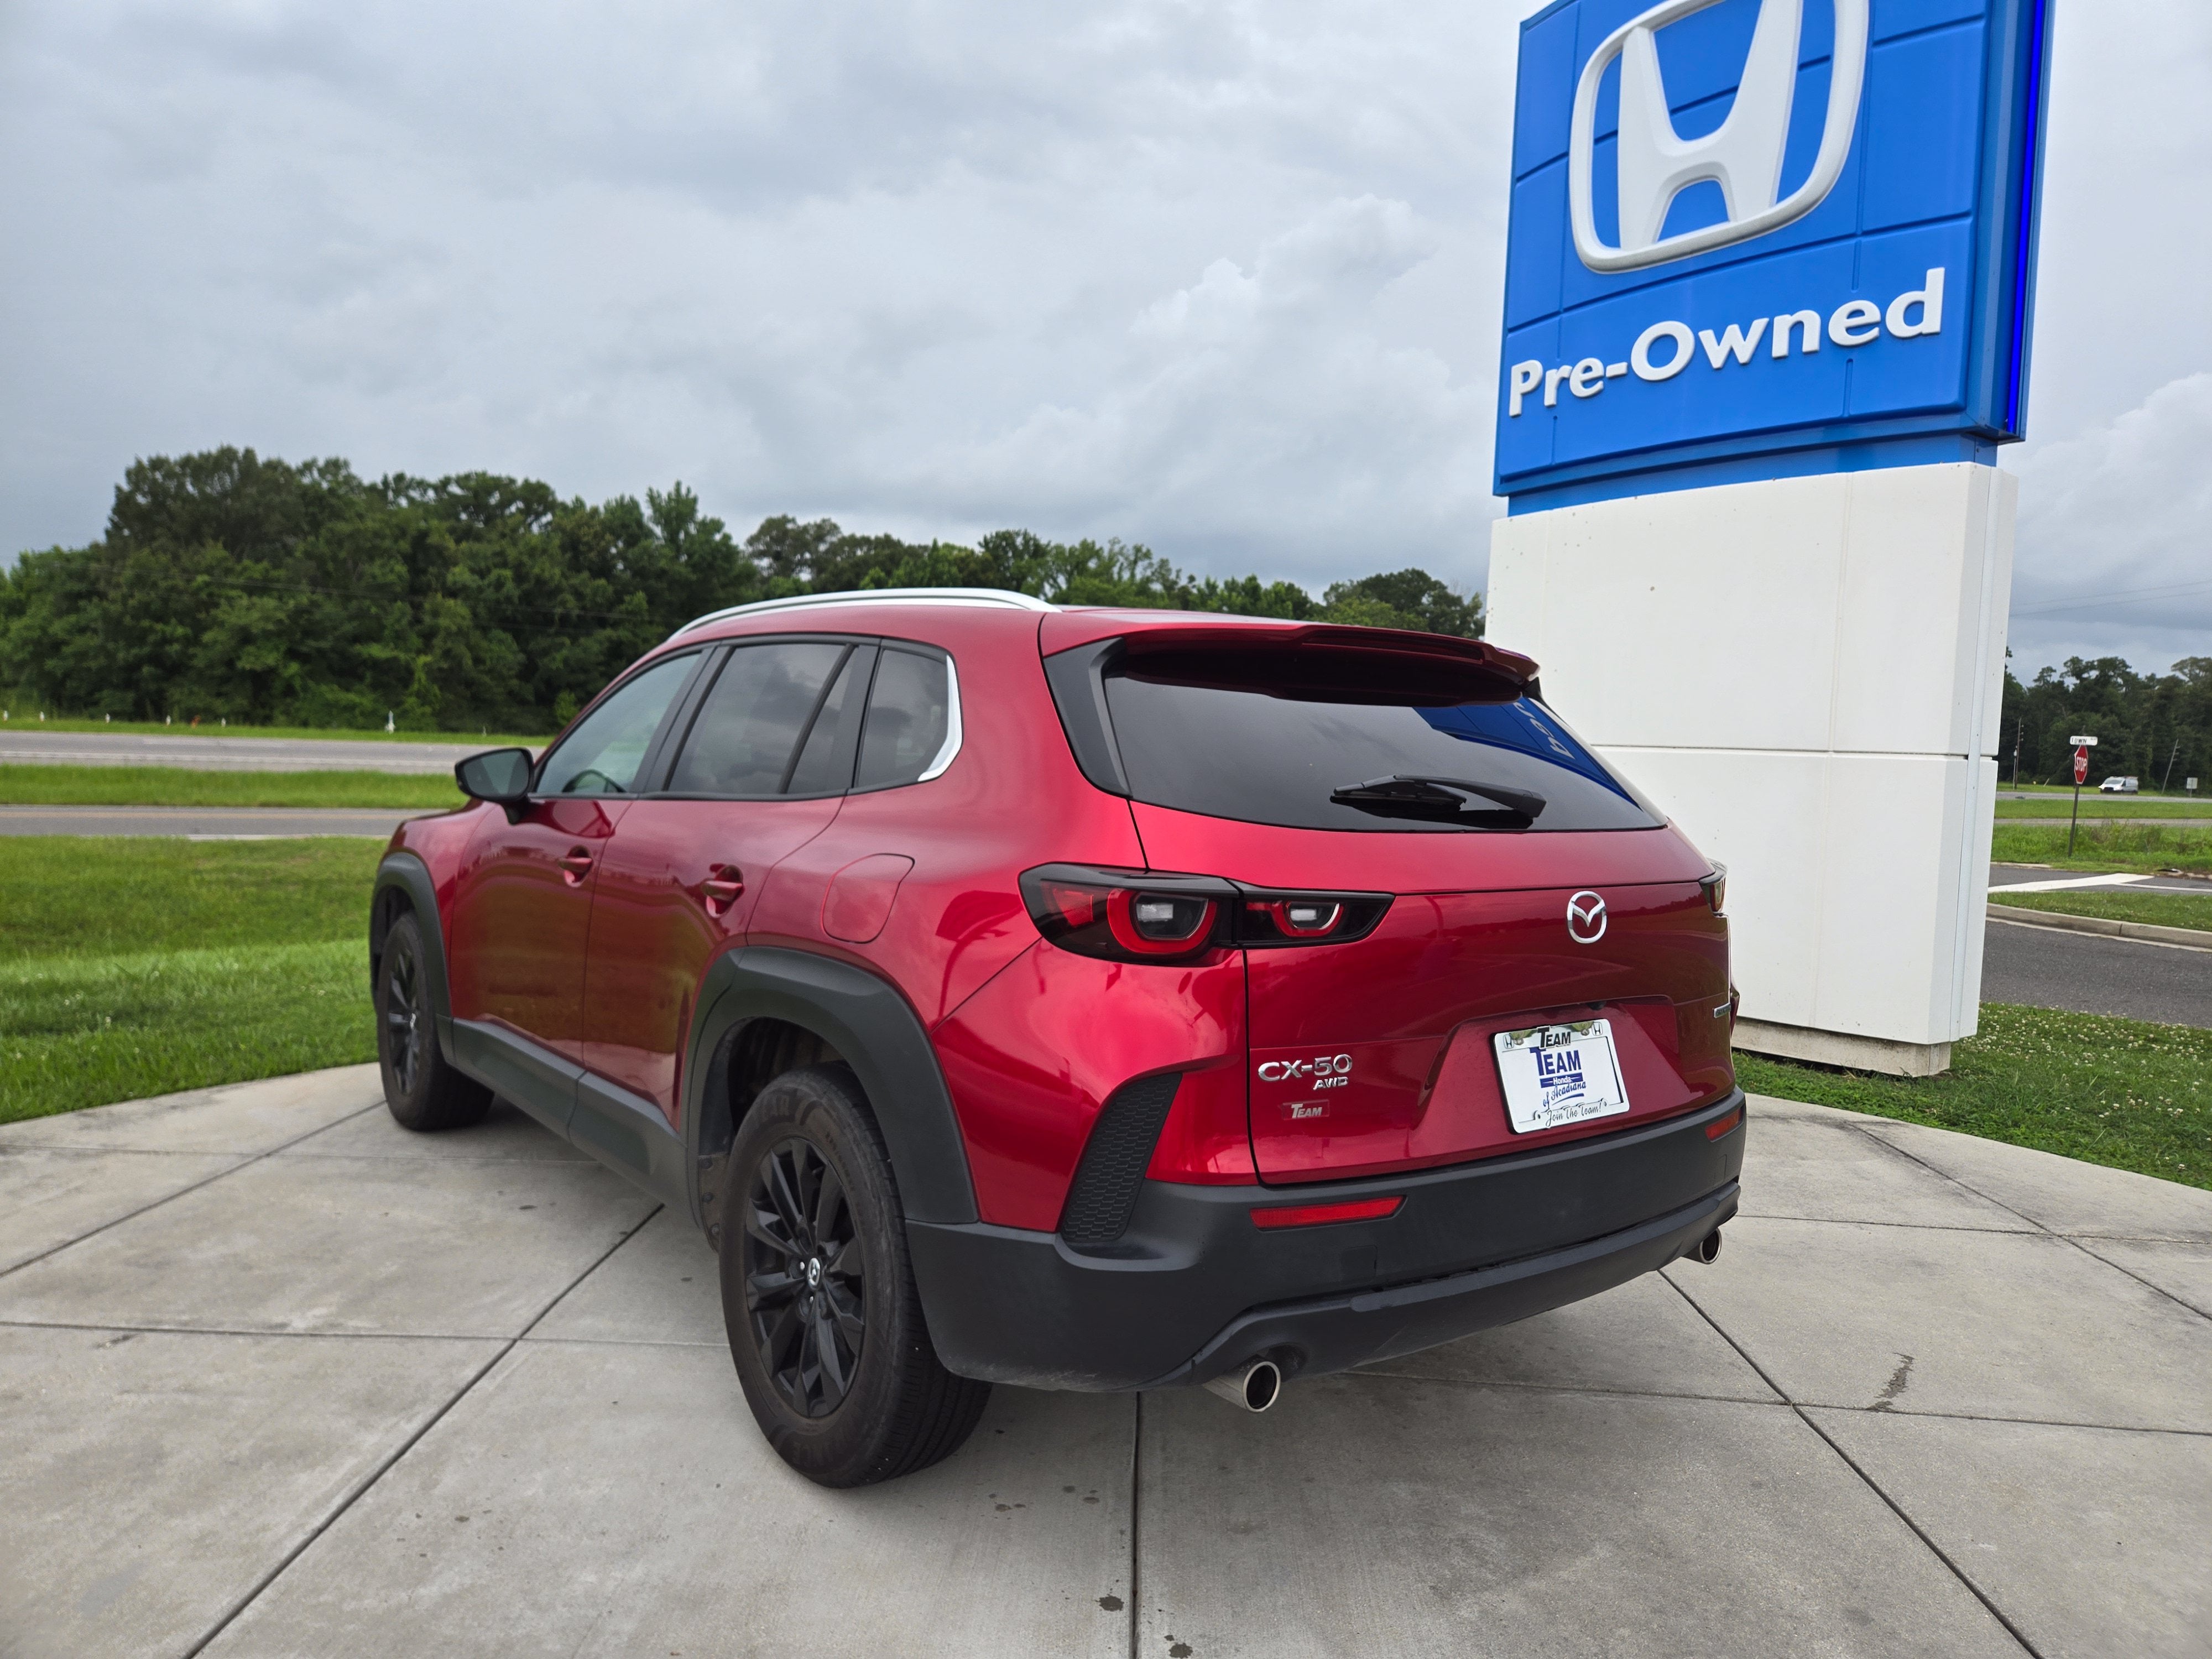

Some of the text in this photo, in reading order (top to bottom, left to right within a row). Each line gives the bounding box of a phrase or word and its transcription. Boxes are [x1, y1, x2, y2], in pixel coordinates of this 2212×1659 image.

[1509, 267, 1945, 418] Pre-Owned
[2076, 757, 2087, 772] STOP
[1537, 1027, 1571, 1048] TEAM
[1258, 1054, 1353, 1081] CX-50
[1530, 1047, 1582, 1076] TEAM
[1313, 1076, 1348, 1091] AWD
[1543, 1092, 1550, 1109] of
[1291, 1103, 1322, 1119] TEAM
[1546, 1110, 1563, 1127] Join
